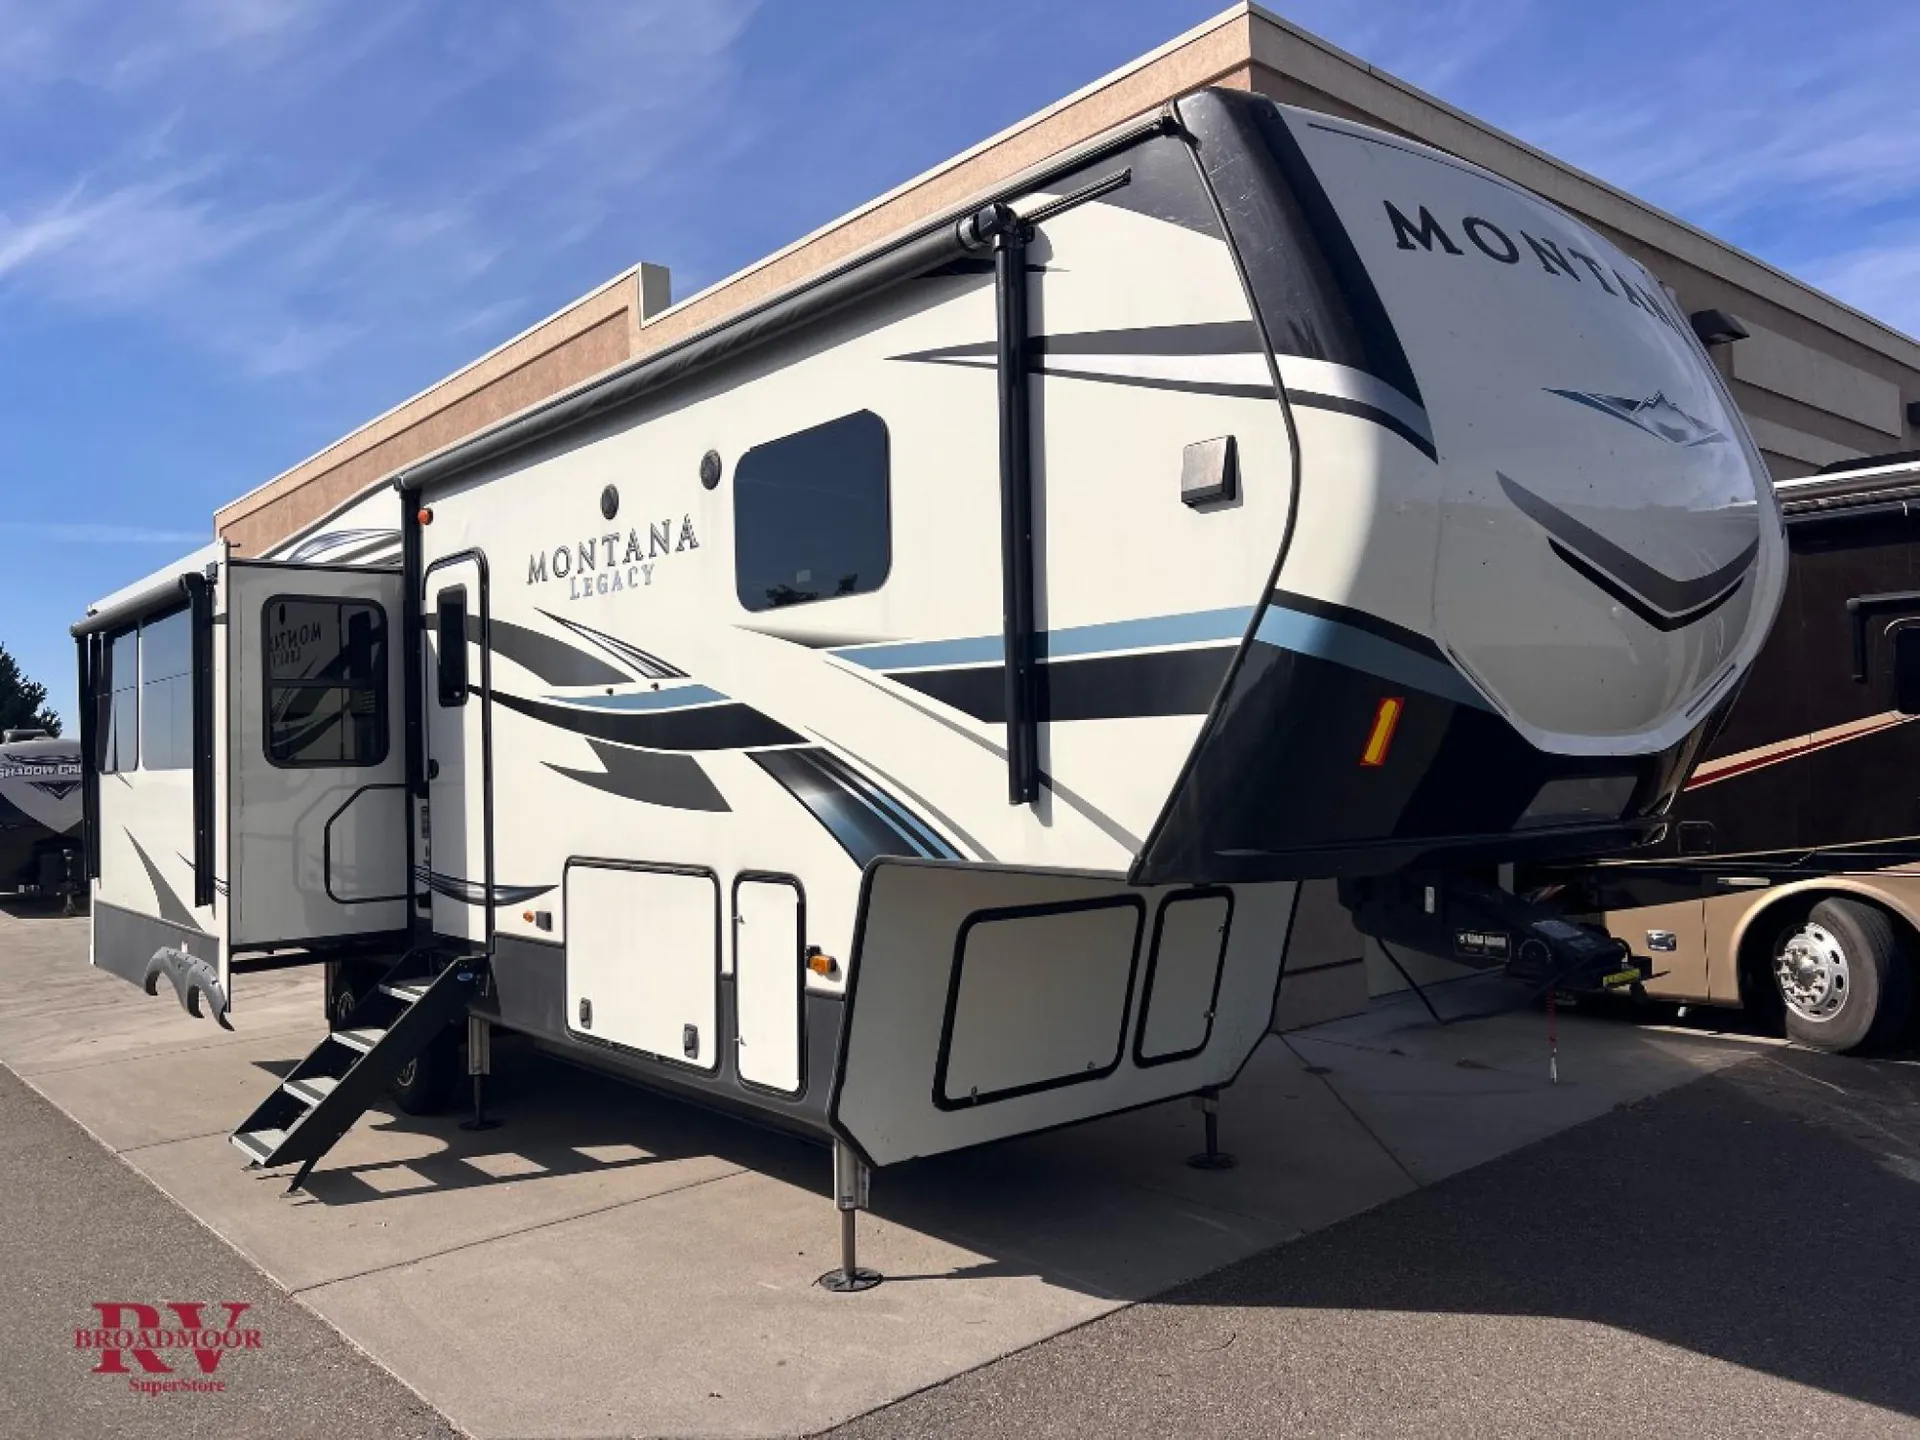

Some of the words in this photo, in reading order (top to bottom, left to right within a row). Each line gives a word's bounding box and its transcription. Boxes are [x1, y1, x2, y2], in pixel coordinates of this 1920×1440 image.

[1383, 200, 1680, 334] MONTAN
[526, 513, 700, 585] MONTANA
[569, 564, 656, 600] LEGACY
